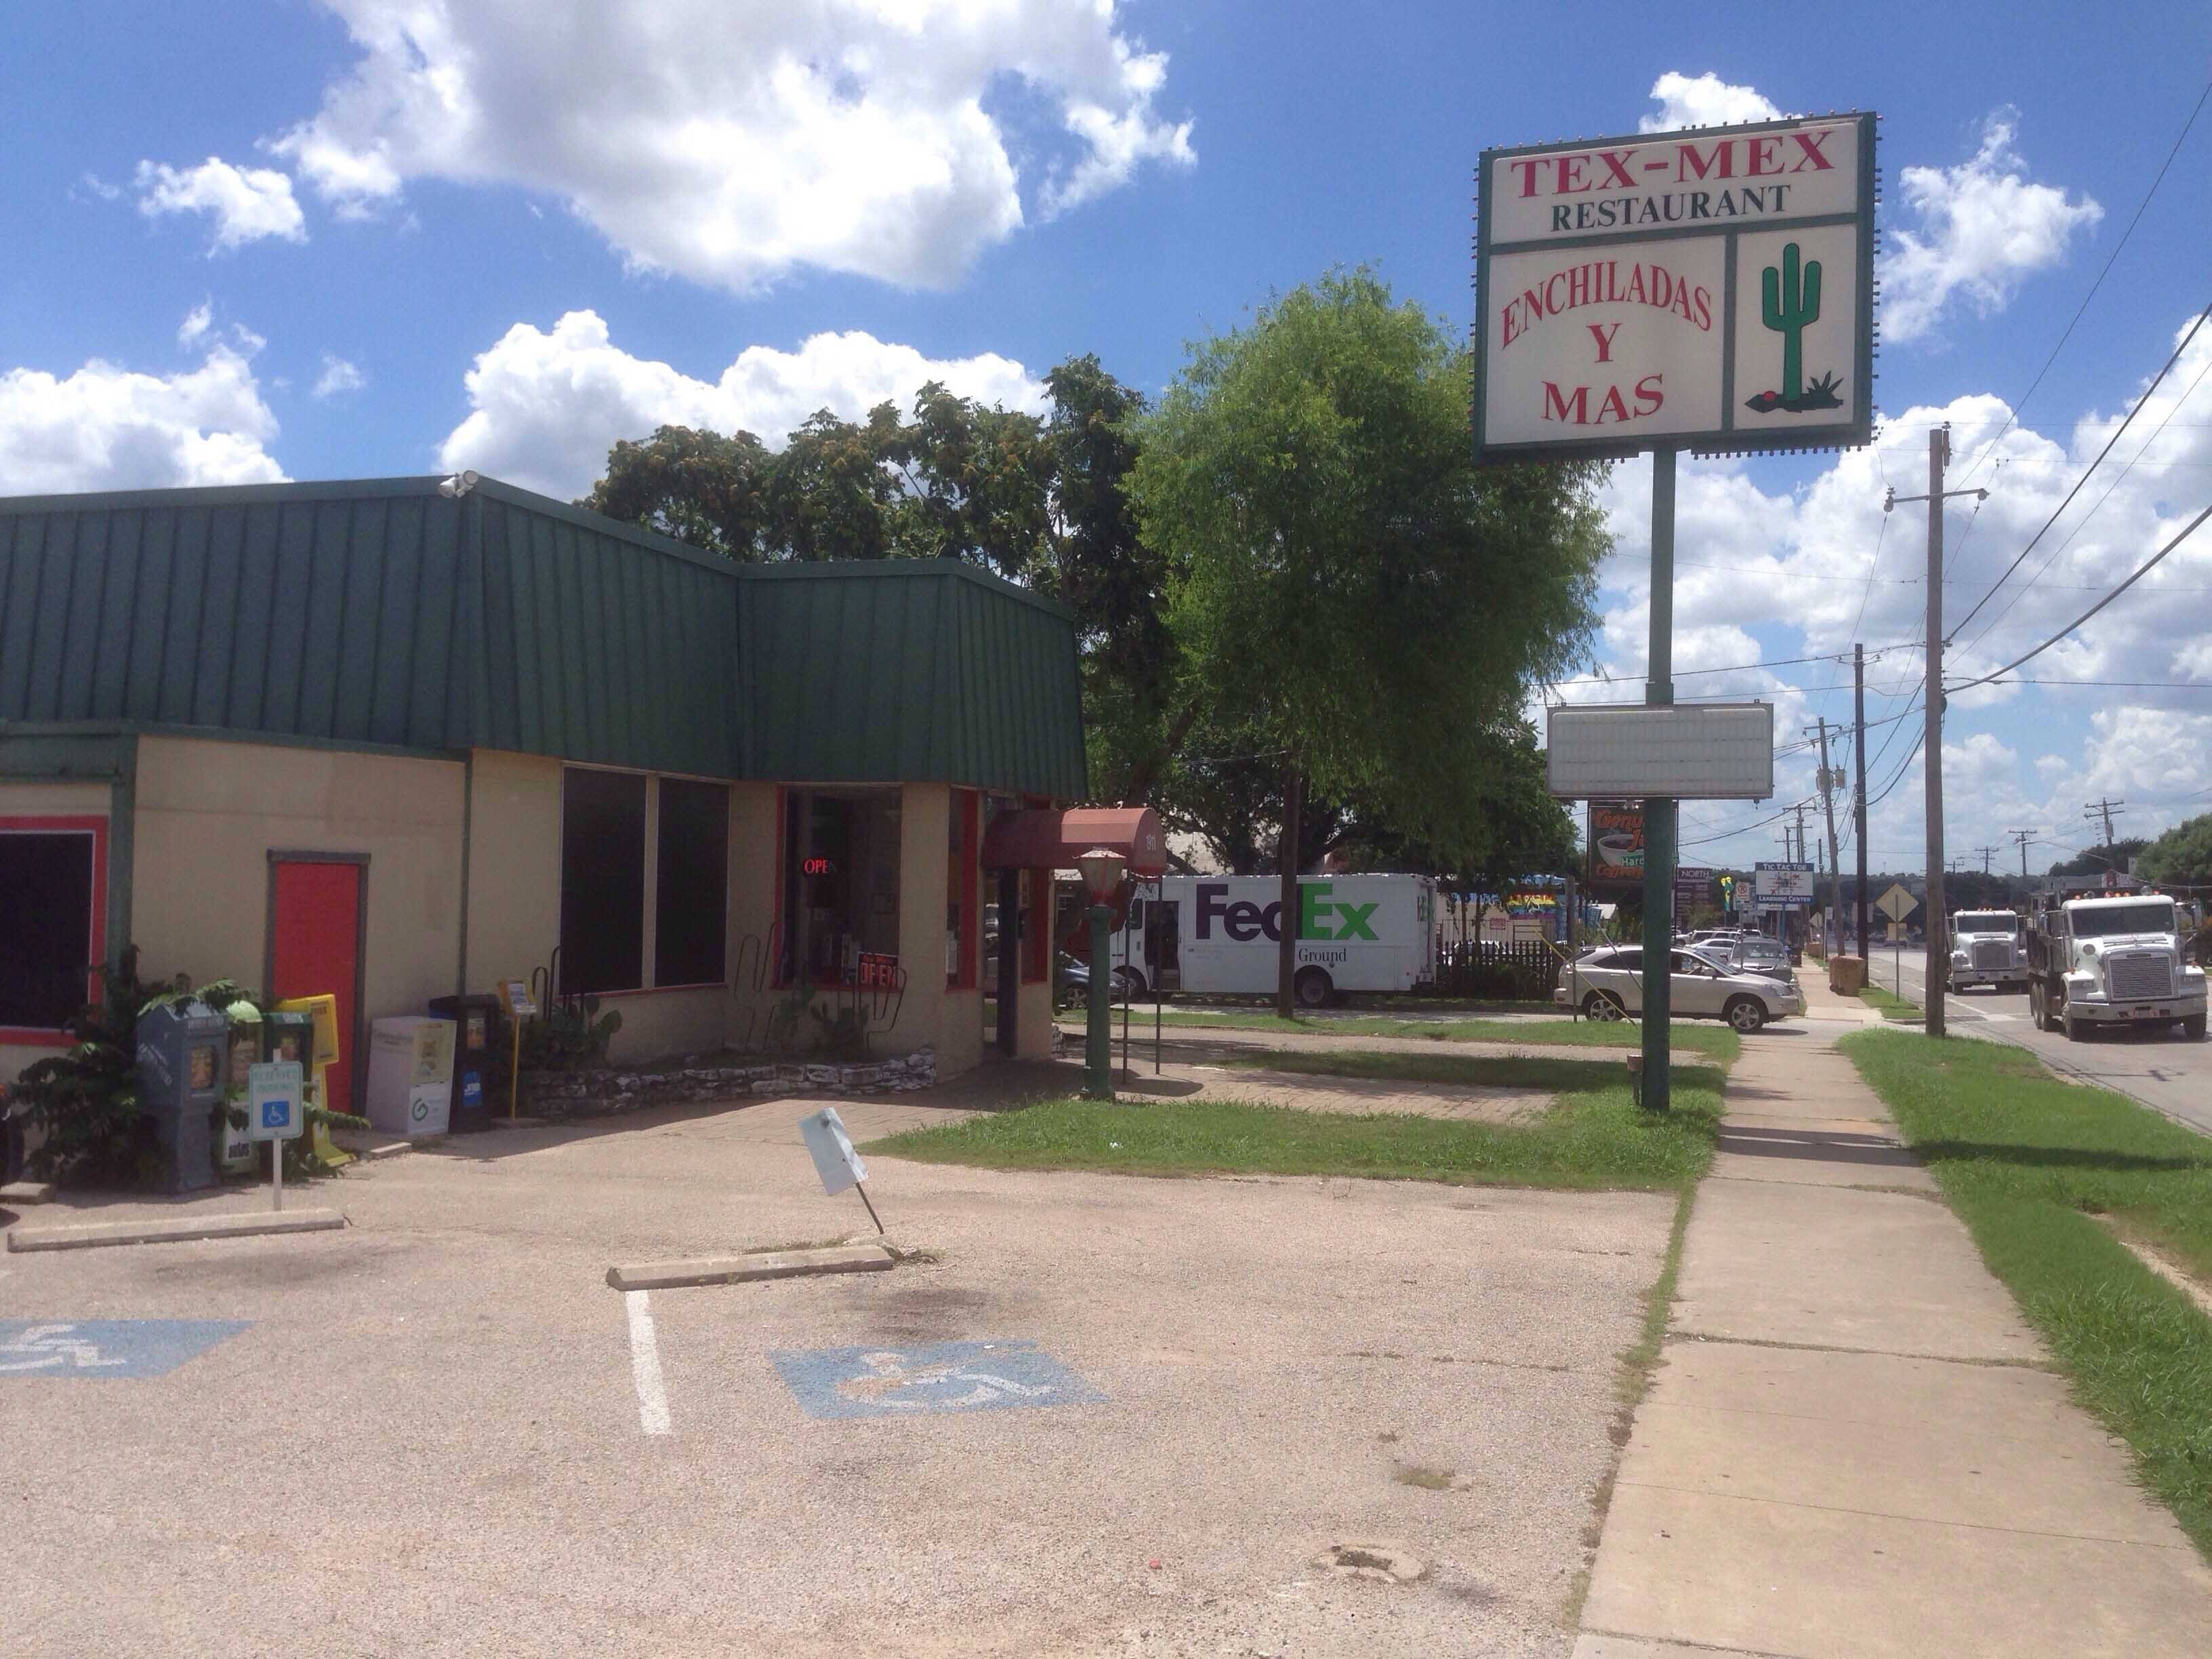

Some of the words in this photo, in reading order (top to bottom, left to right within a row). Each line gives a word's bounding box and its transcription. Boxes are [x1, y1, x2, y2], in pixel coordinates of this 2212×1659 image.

[1511, 131, 1835, 198] TEX-MEX
[1550, 184, 1791, 232] RESTAURANT
[1500, 260, 1712, 350] ENCHILADAS
[1586, 323, 1622, 363] Y
[1540, 373, 1664, 425] MAS
[1681, 869, 1709, 878] NORTH
[1196, 882, 1380, 942] FedEx
[1298, 948, 1347, 962] Ground
